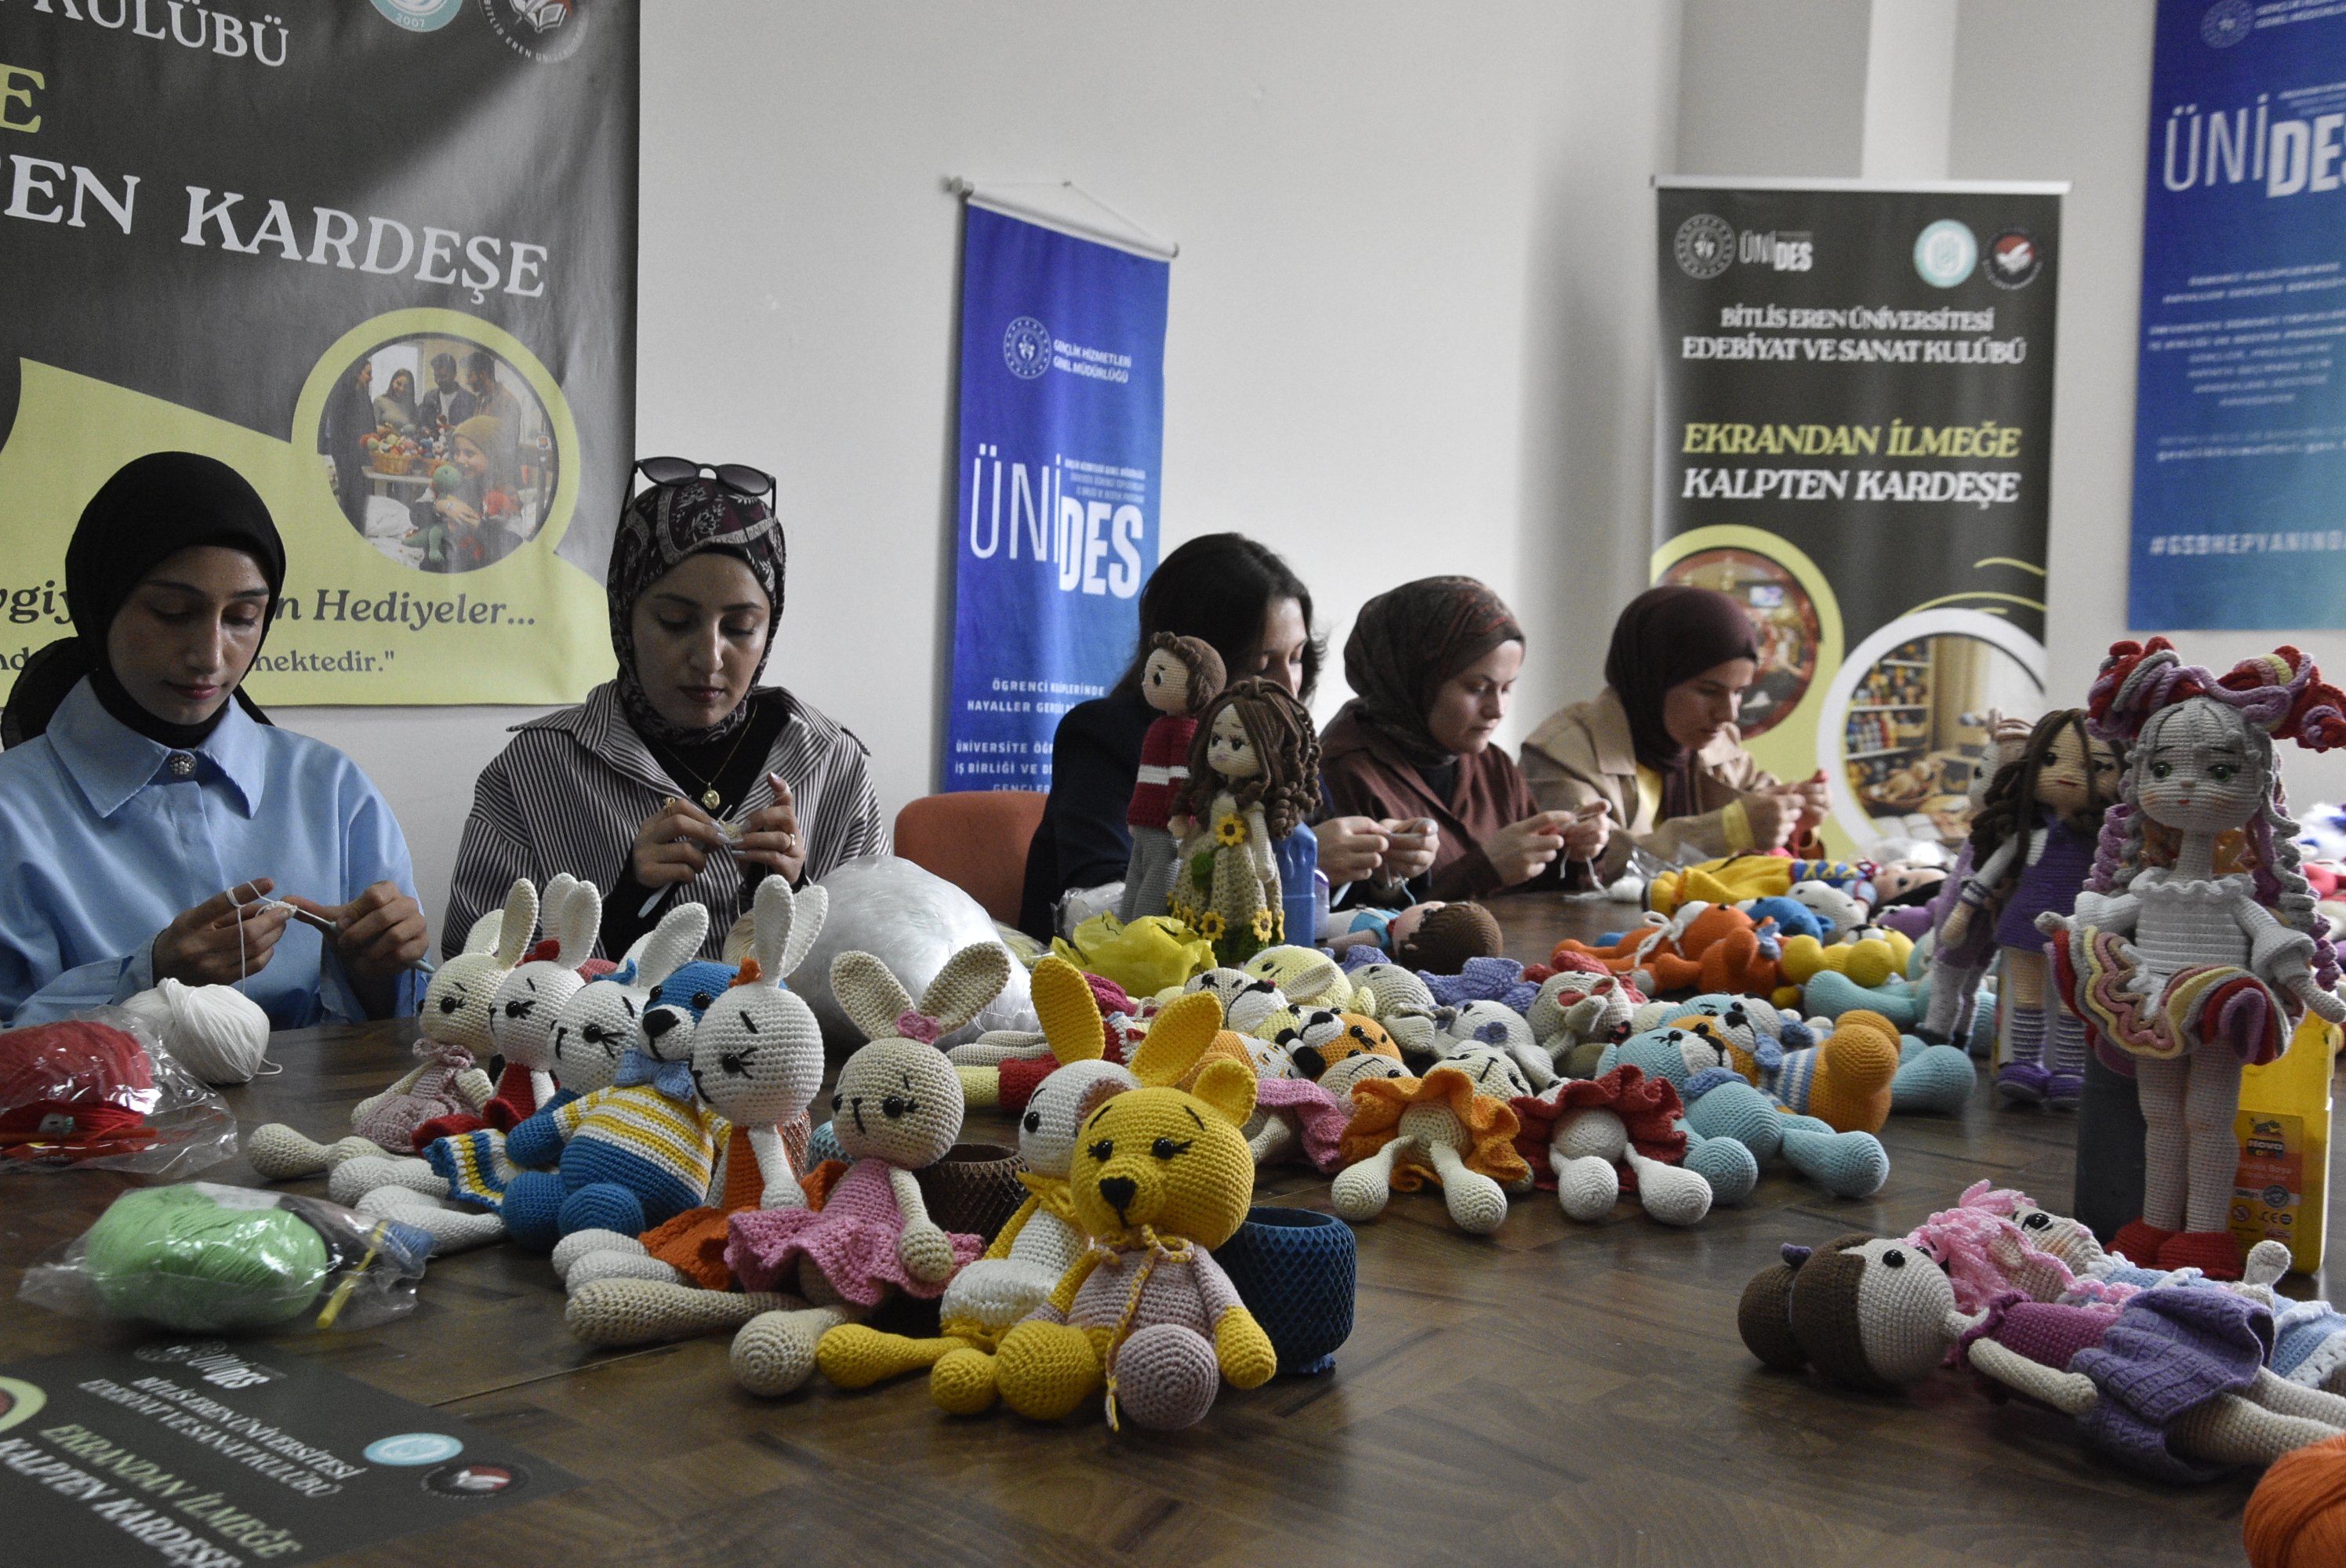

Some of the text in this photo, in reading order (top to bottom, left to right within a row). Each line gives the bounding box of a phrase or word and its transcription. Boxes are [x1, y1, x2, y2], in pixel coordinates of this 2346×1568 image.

[34, 0, 289, 67] ULÜBÜ
[395, 13, 426, 29] 2007
[505, 36, 532, 58] EREN
[2163, 93, 2346, 198] ÜNİDE
[180, 185, 548, 304] KARDEŞE
[1720, 303, 1995, 331] BİTLİS EREN ÜNİVERSİTESİ
[1682, 332, 2027, 365] EDEBİYAT VE SANAT KULÜBÜ
[1682, 418, 2023, 458] EKRANDAN İLMEĞE
[1682, 468, 2022, 510] KALPTEN KARDEŞE
[313, 589, 536, 631] Hediyeler...
[967, 699, 1031, 713] HAYALLER
[955, 739, 1028, 754] ÜNİVERSİTE
[954, 760, 964, 776] İŞ
[968, 760, 1015, 775] BİRLİĞİ
[1020, 764, 1037, 775] VE
[0, 1438, 119, 1501] KALPTEN
[40, 1424, 197, 1497] EKRANDAN
